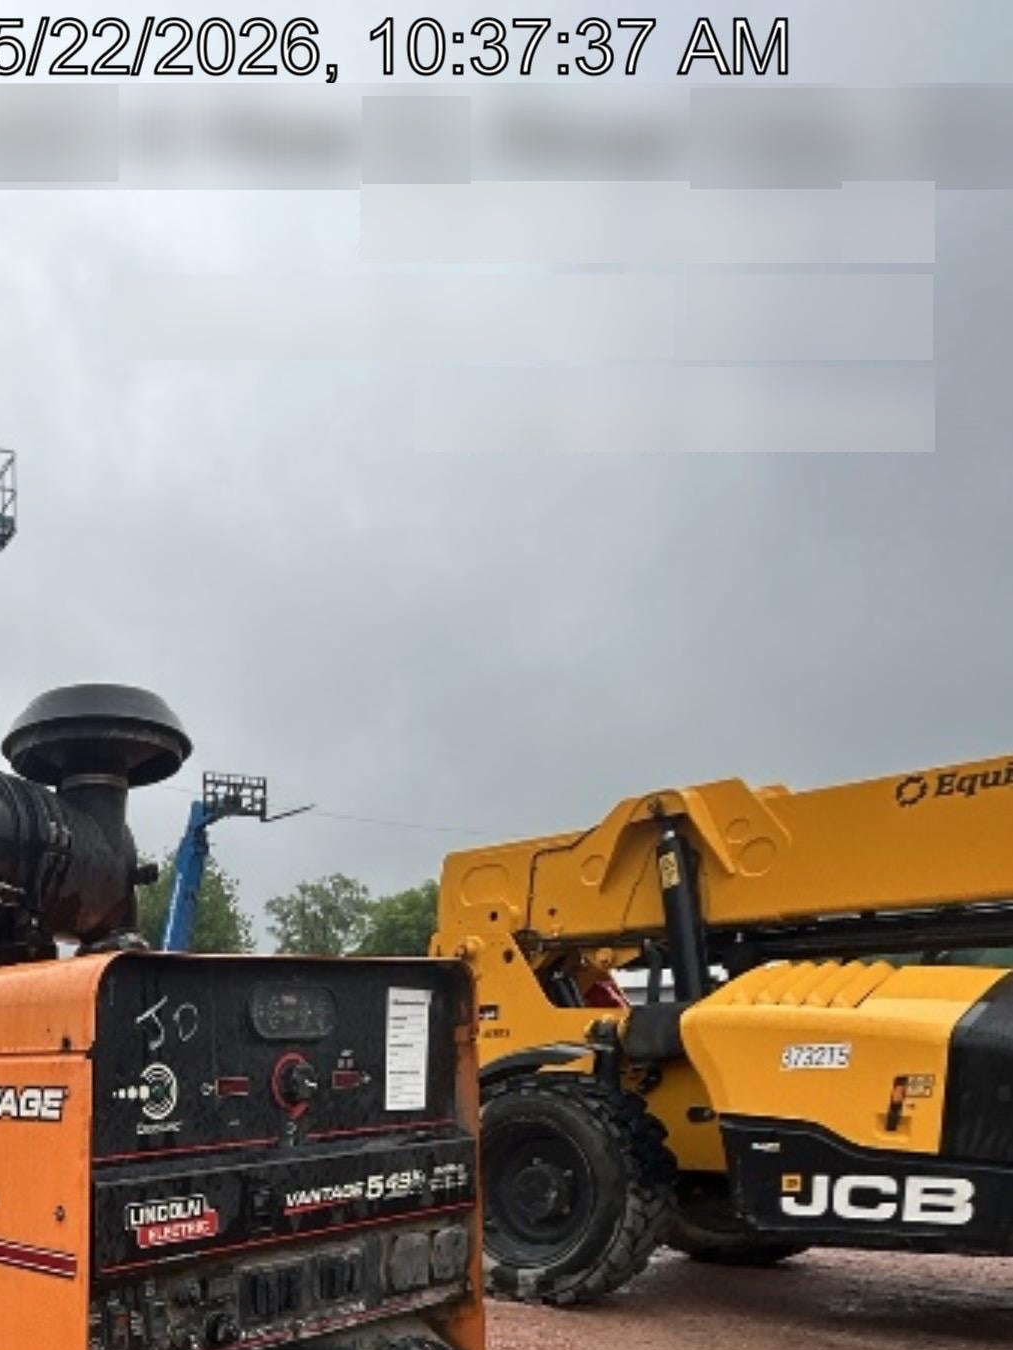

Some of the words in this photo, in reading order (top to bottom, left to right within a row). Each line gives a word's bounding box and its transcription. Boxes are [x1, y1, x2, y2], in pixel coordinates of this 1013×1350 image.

[782, 1045, 850, 1069] 373215
[130, 1198, 202, 1226] LINCOLN
[781, 1174, 975, 1225] JCB
[149, 1219, 211, 1241] ELECTRIC
